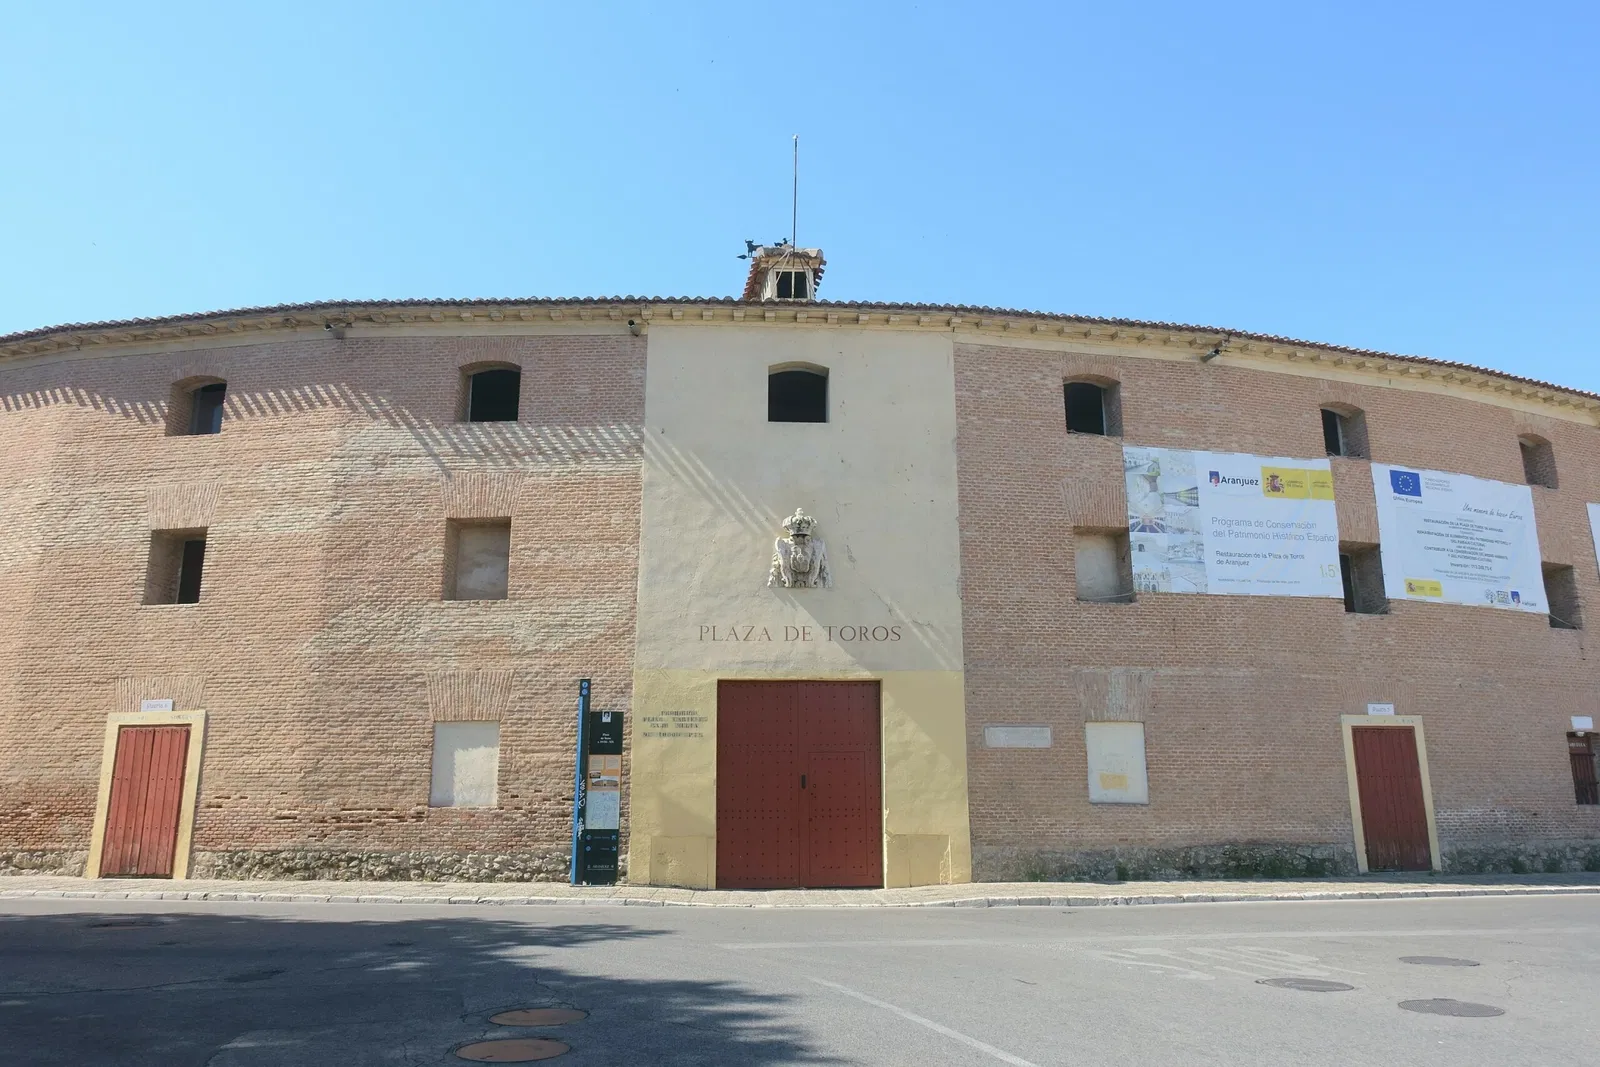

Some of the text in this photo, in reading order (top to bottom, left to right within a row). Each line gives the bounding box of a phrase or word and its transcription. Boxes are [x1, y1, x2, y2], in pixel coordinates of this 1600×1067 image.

[1220, 476, 1259, 486] Aranjuez
[1211, 517, 1252, 528] Programa
[1254, 520, 1264, 528] de
[1212, 529, 1226, 538] del
[1228, 530, 1271, 540] Patrimonio
[1307, 532, 1337, 542] Español
[1215, 550, 1253, 558] Restauración
[1225, 559, 1249, 567] Aranjuez
[699, 625, 902, 642] PLAZA DE TOROS
